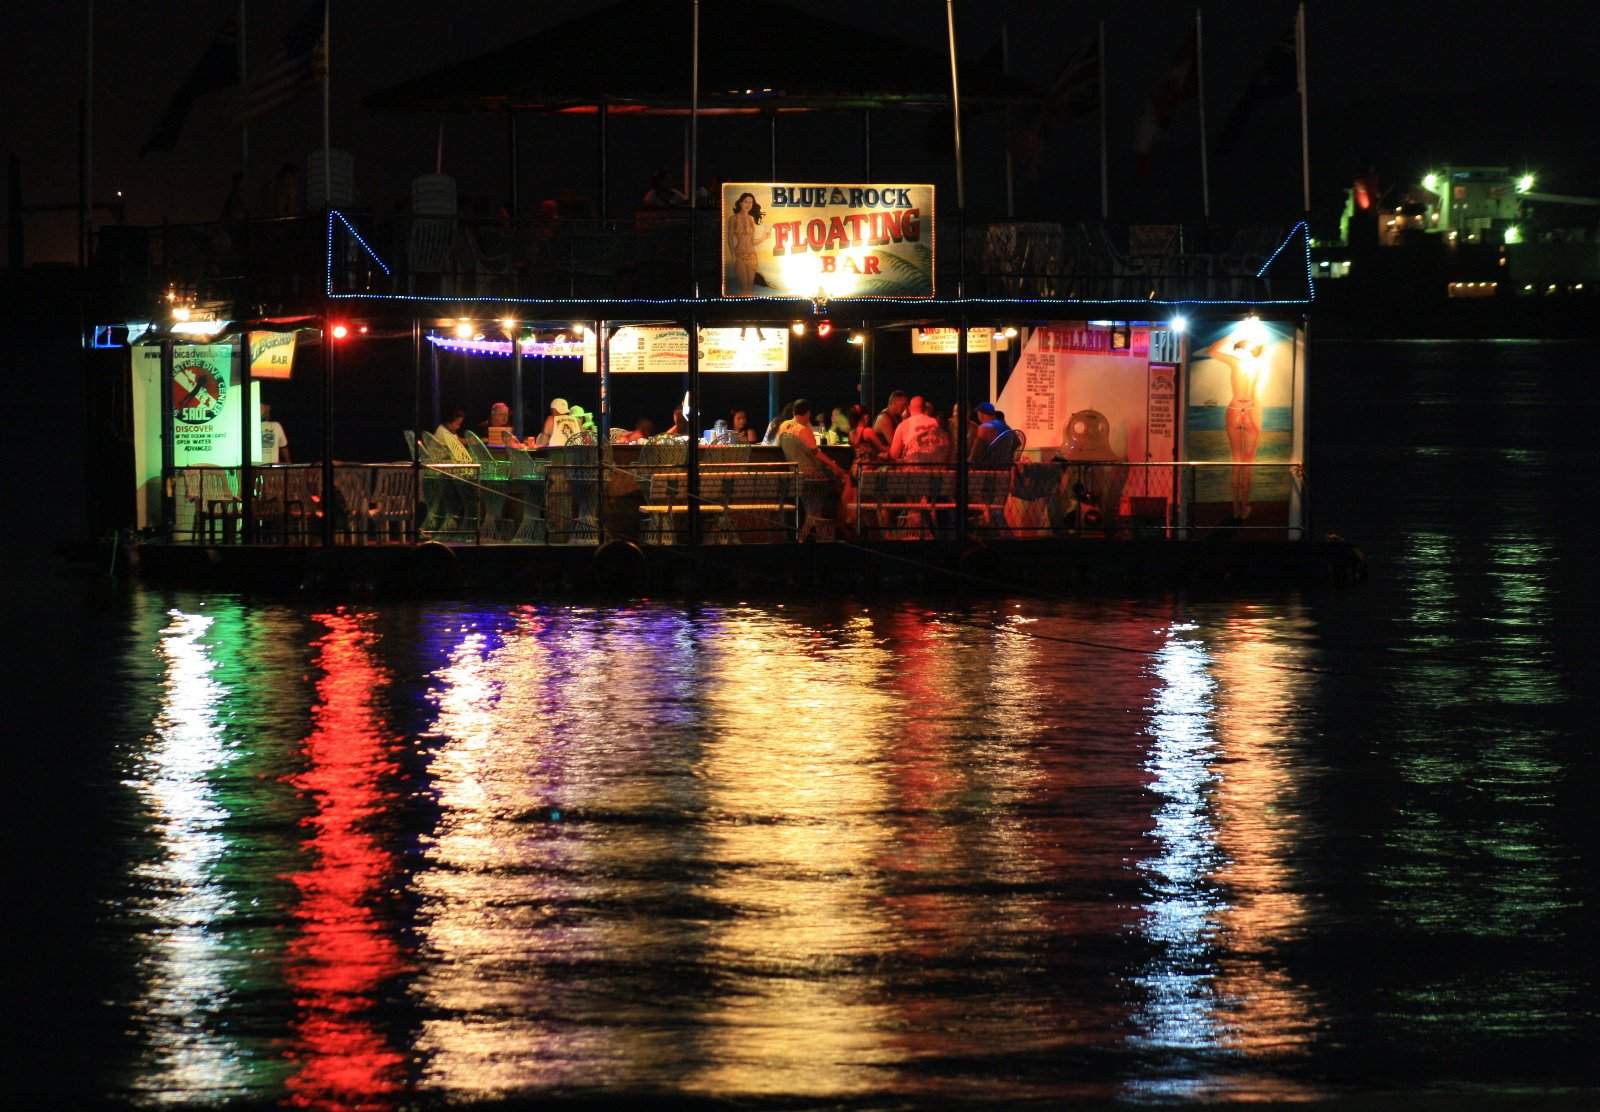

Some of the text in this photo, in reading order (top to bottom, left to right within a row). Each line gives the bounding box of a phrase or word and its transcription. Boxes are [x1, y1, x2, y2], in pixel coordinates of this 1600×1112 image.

[771, 187, 913, 208] BLUE ROCK
[773, 208, 921, 256] FLOATING
[820, 256, 881, 274] BAR
[202, 361, 221, 380] DIVE
